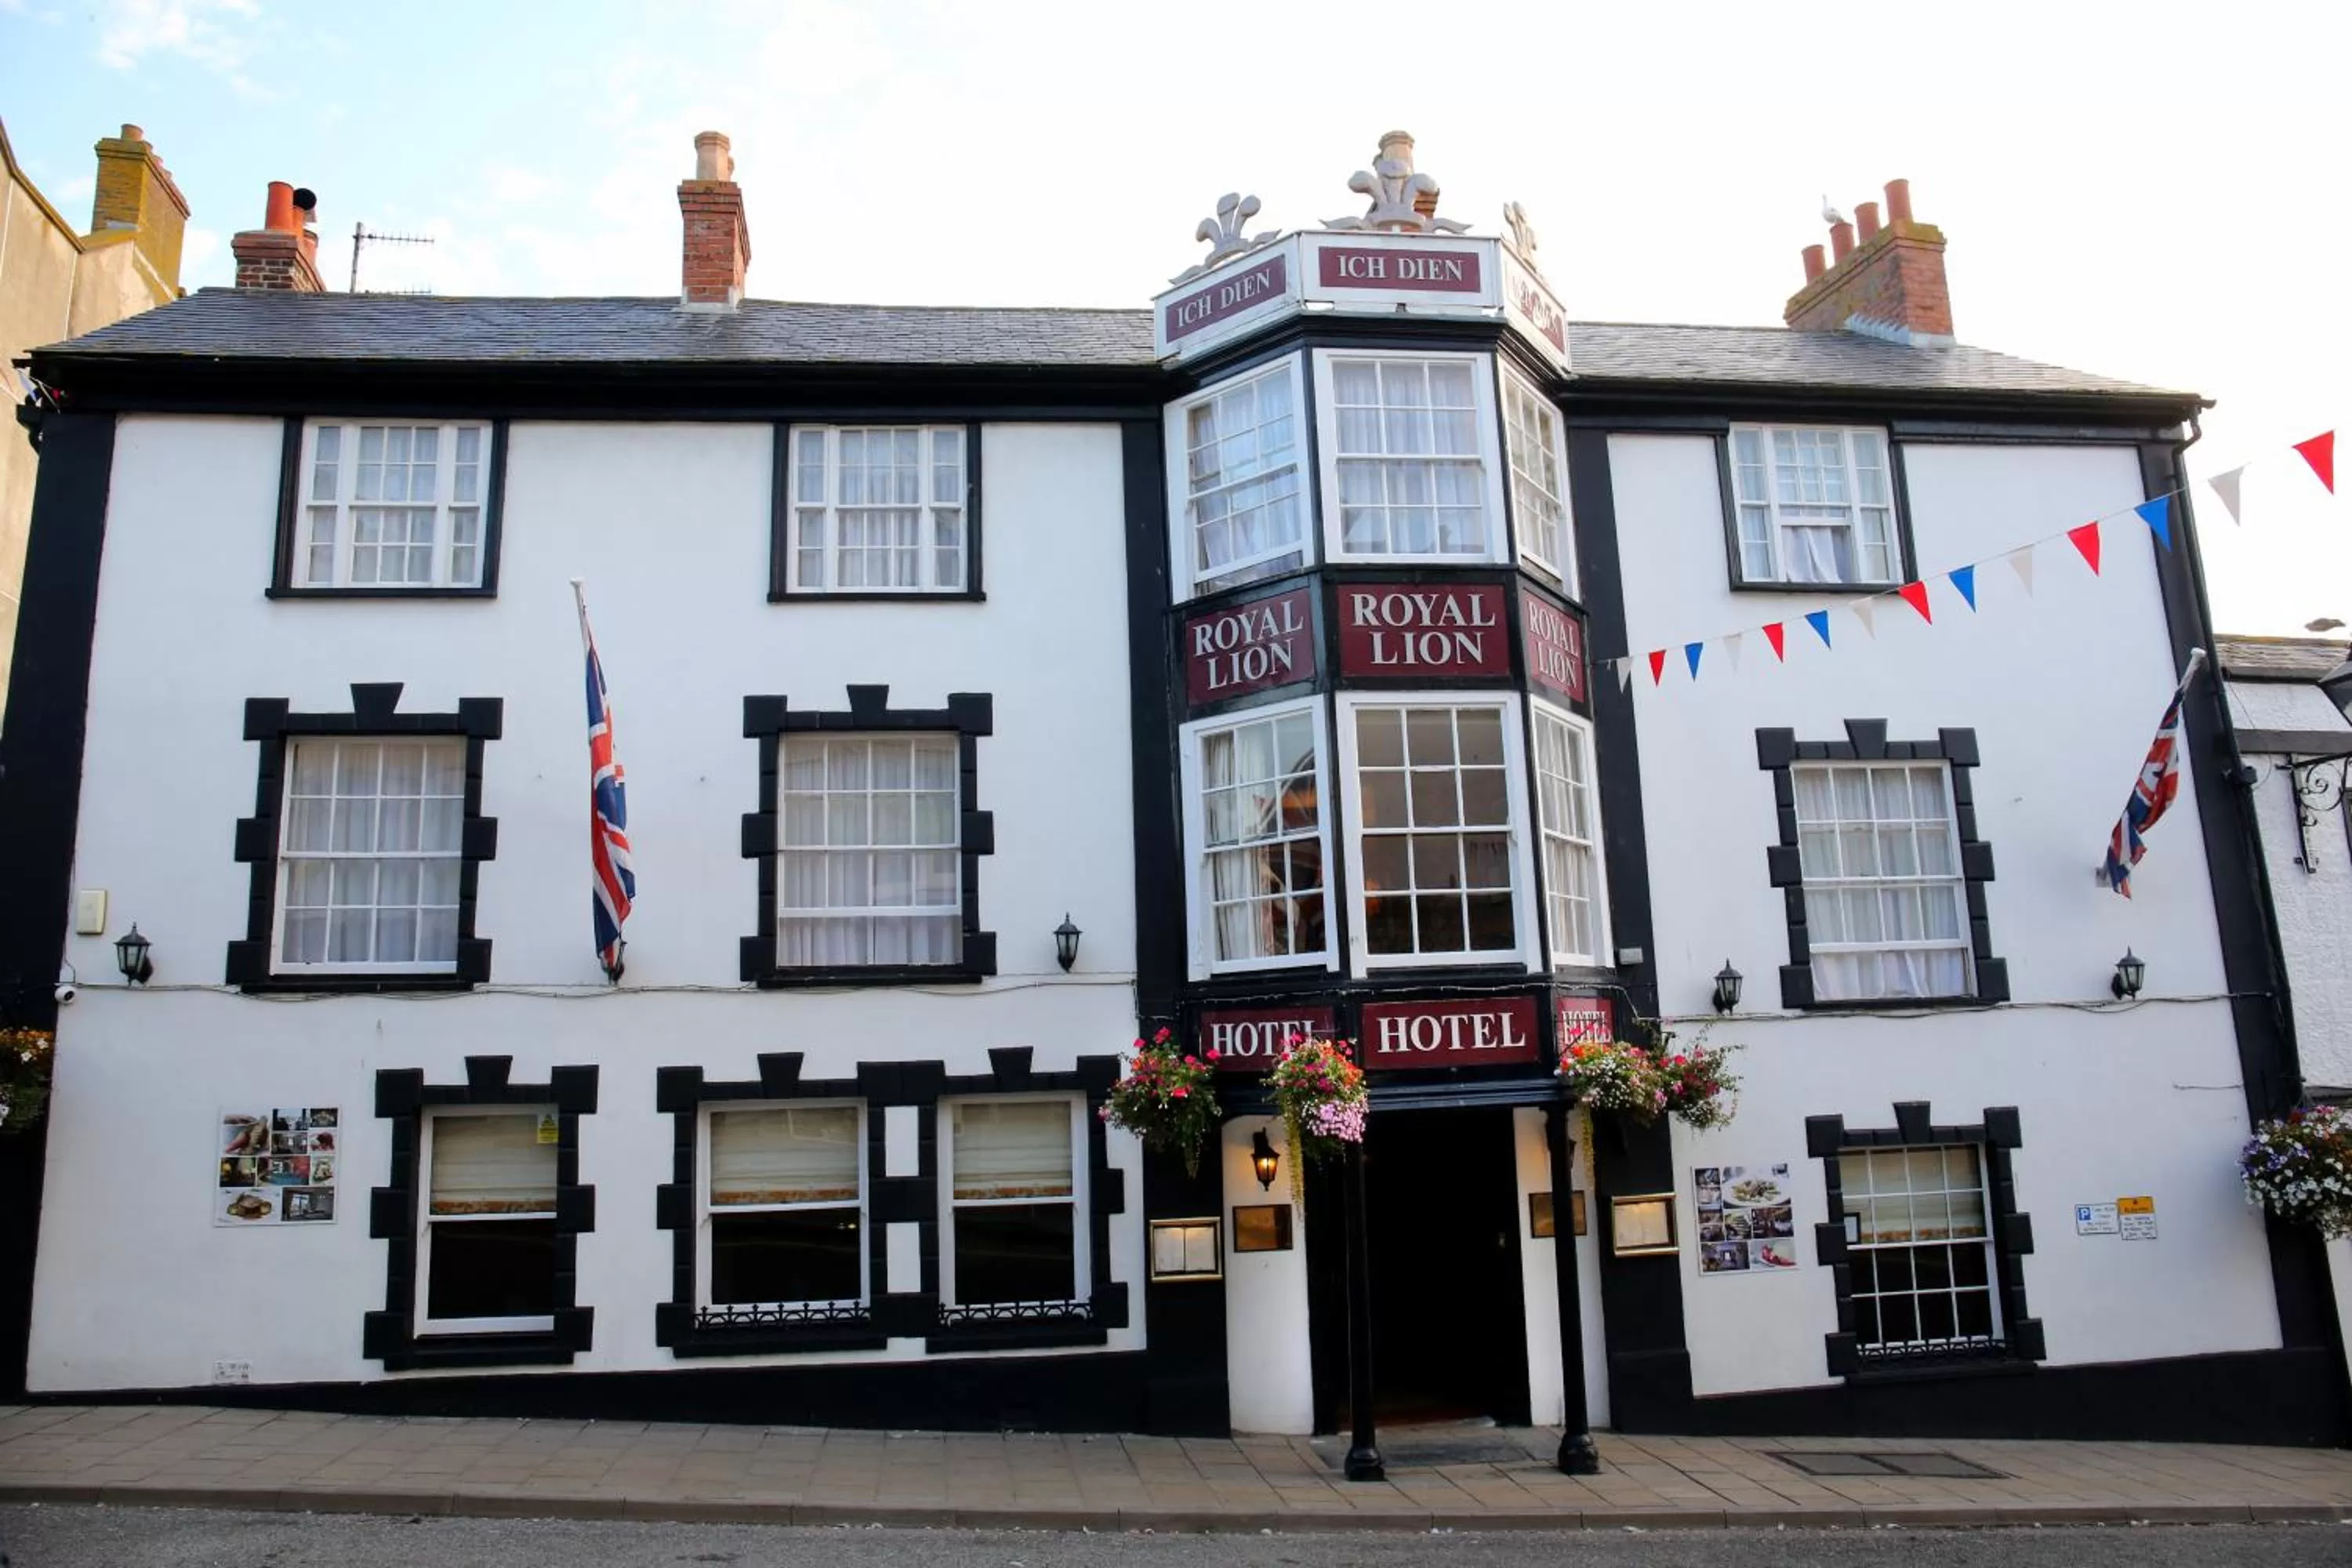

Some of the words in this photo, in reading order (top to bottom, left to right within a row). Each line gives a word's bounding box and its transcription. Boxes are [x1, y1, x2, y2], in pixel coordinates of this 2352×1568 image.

[1337, 255, 1387, 279] ICH
[1397, 257, 1464, 282] DIEN
[1177, 295, 1213, 327] ICH
[1220, 268, 1270, 310] DIEN
[1192, 600, 1305, 658] ROYAL
[1350, 593, 1496, 627] ROYAL
[1526, 598, 1579, 659] ROYAL
[1207, 637, 1294, 691] LION
[1369, 631, 1484, 665] LION
[1537, 640, 1578, 689] LION
[1377, 1011, 1526, 1054] HOTEL
